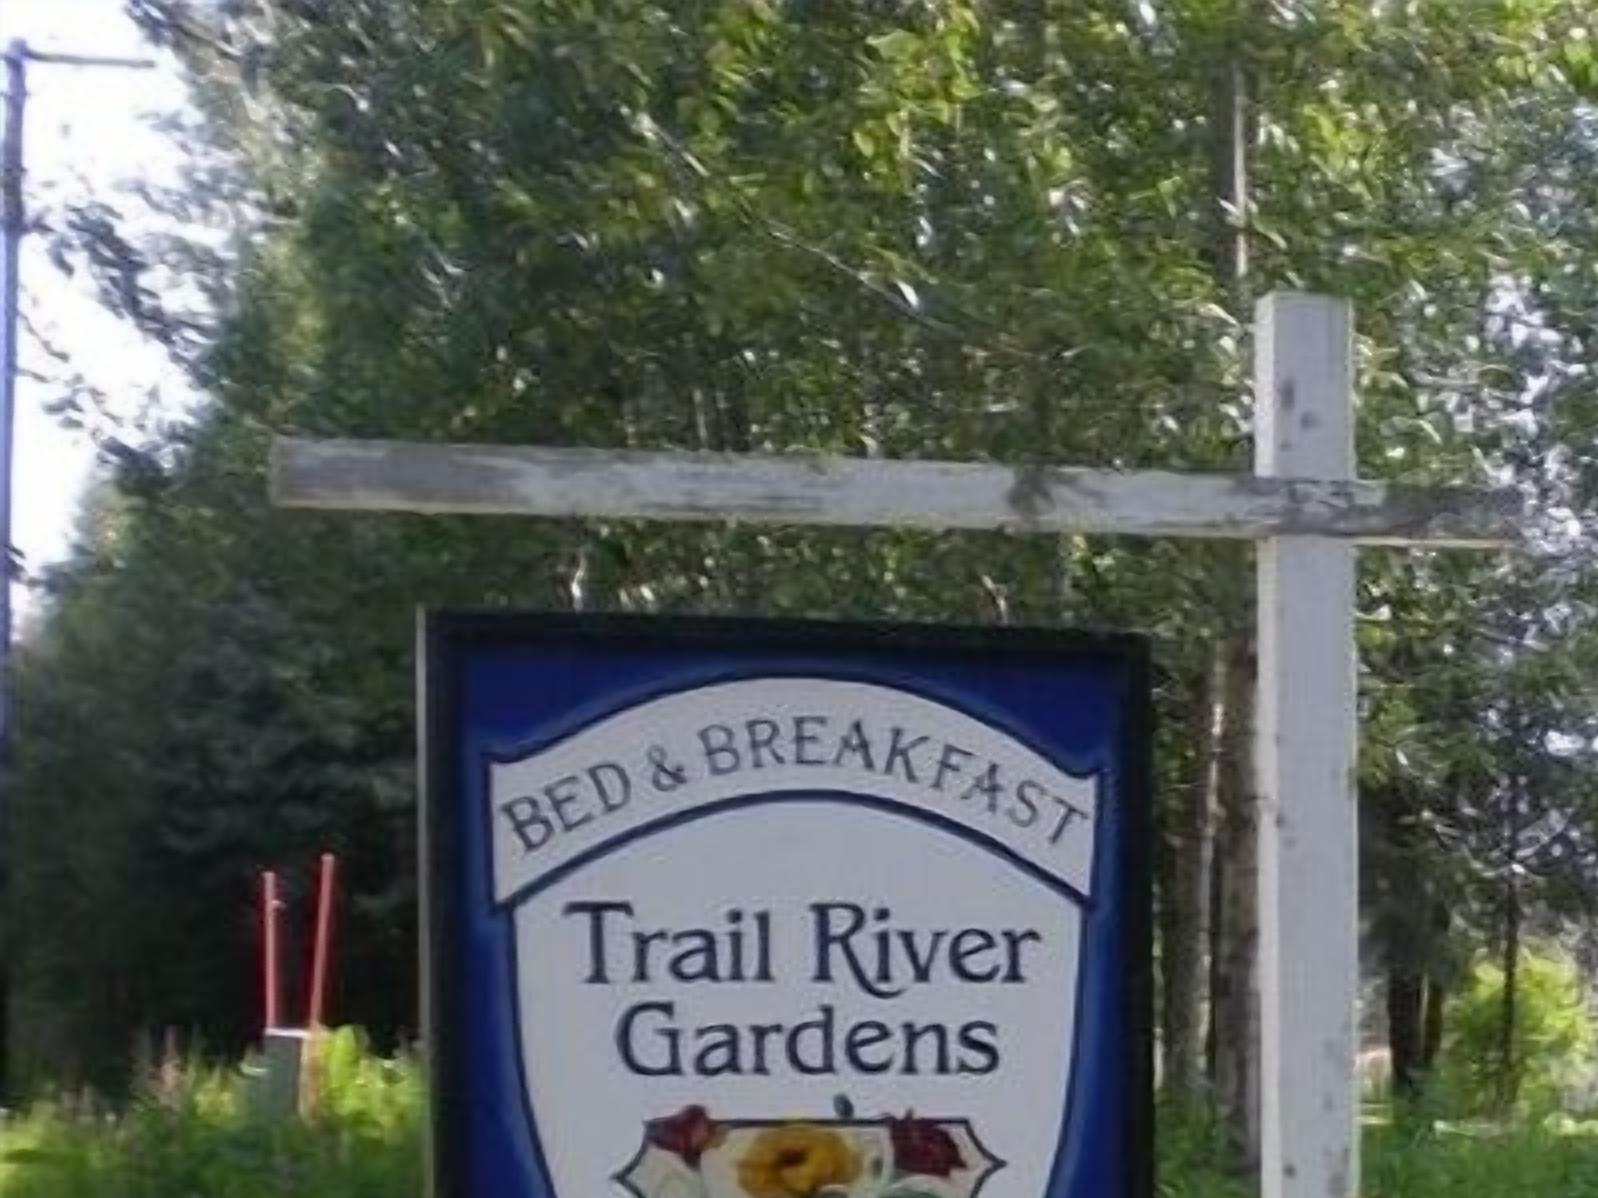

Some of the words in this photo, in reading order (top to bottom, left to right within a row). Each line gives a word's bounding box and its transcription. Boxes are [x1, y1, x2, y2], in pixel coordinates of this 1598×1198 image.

[503, 763, 631, 853] BED
[648, 745, 688, 792] &
[697, 715, 1088, 845] BREAKFAST
[563, 902, 774, 985] Trail
[811, 902, 1042, 1000] River
[616, 1001, 1000, 1078] Gardens
